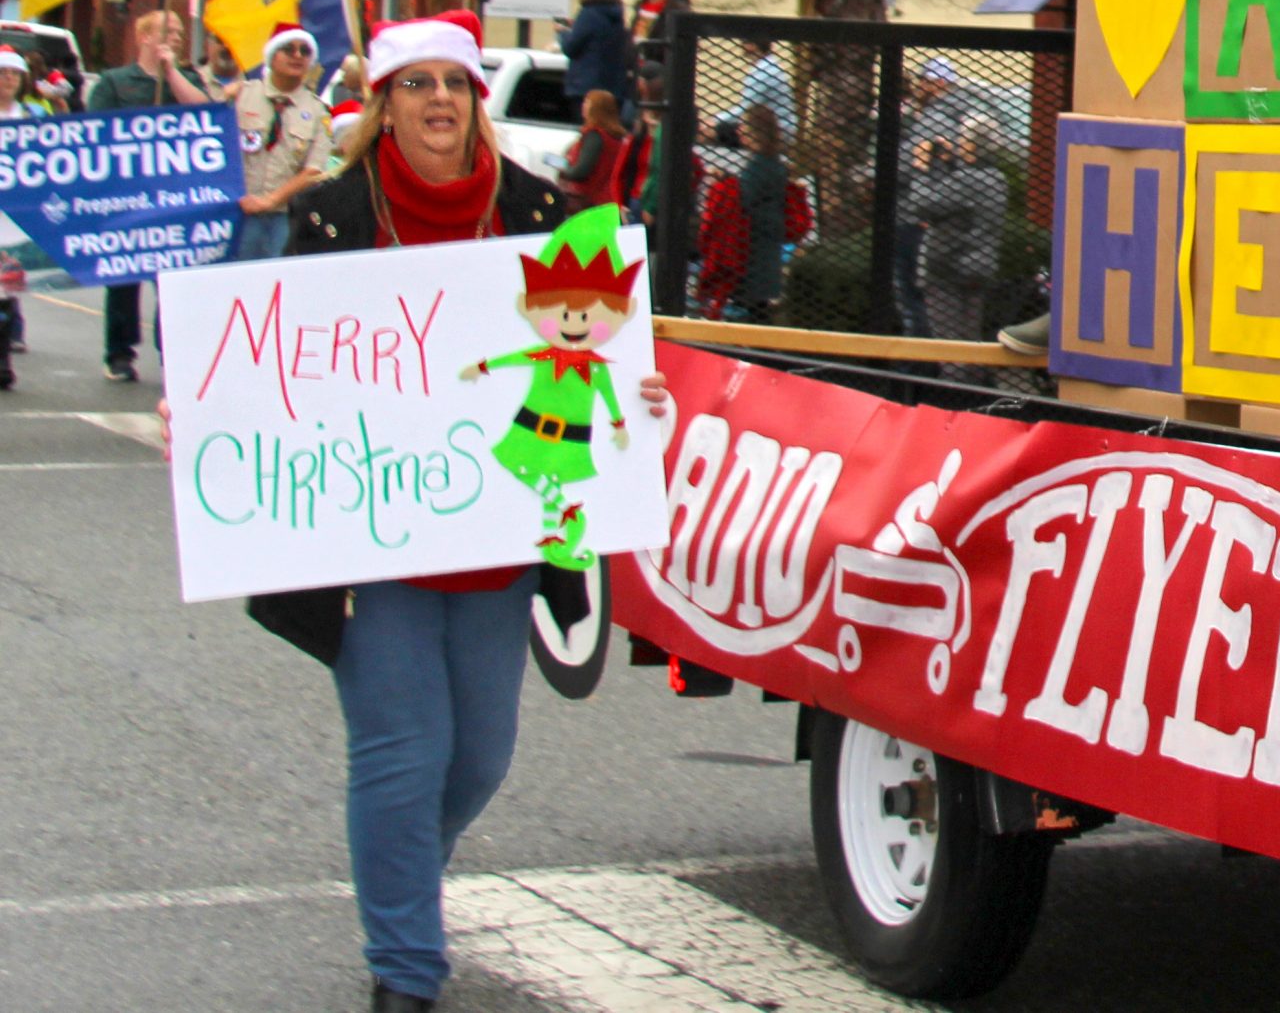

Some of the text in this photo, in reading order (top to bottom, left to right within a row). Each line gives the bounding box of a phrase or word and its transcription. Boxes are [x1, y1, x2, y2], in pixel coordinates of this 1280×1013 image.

[112, 110, 223, 140] LOCAL
[0, 137, 227, 190] SCOUTING
[72, 185, 230, 217] Prepared. For Life.
[64, 219, 234, 258] PROVIDE AN
[196, 279, 444, 422] MERRY
